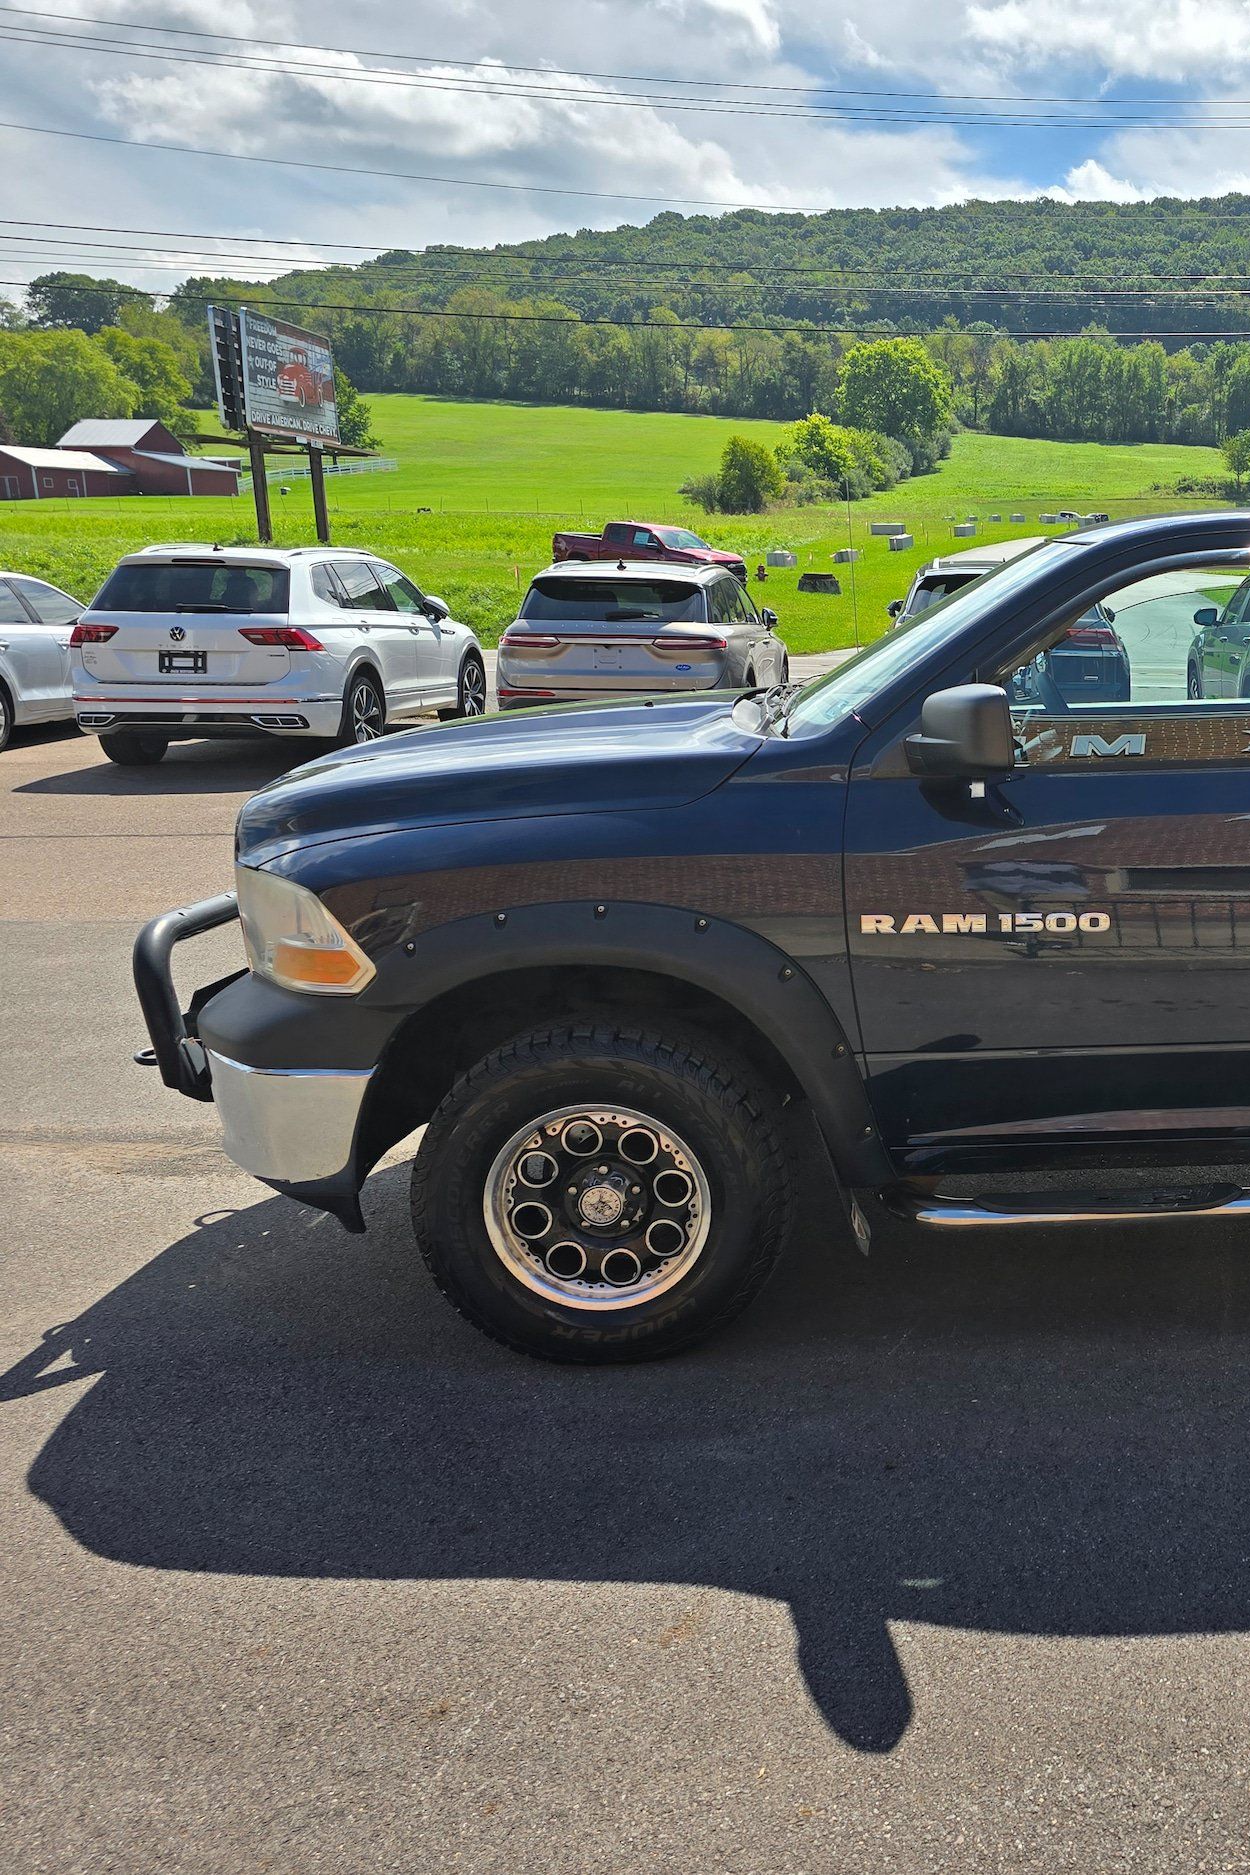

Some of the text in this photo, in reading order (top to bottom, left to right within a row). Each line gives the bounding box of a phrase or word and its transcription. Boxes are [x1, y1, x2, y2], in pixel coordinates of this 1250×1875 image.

[266, 341, 283, 356] GOES
[256, 374, 277, 390] STYLE
[251, 410, 271, 424] DRIVE
[302, 420, 319, 434] DRIVE
[860, 911, 1111, 934] RAM 1500
